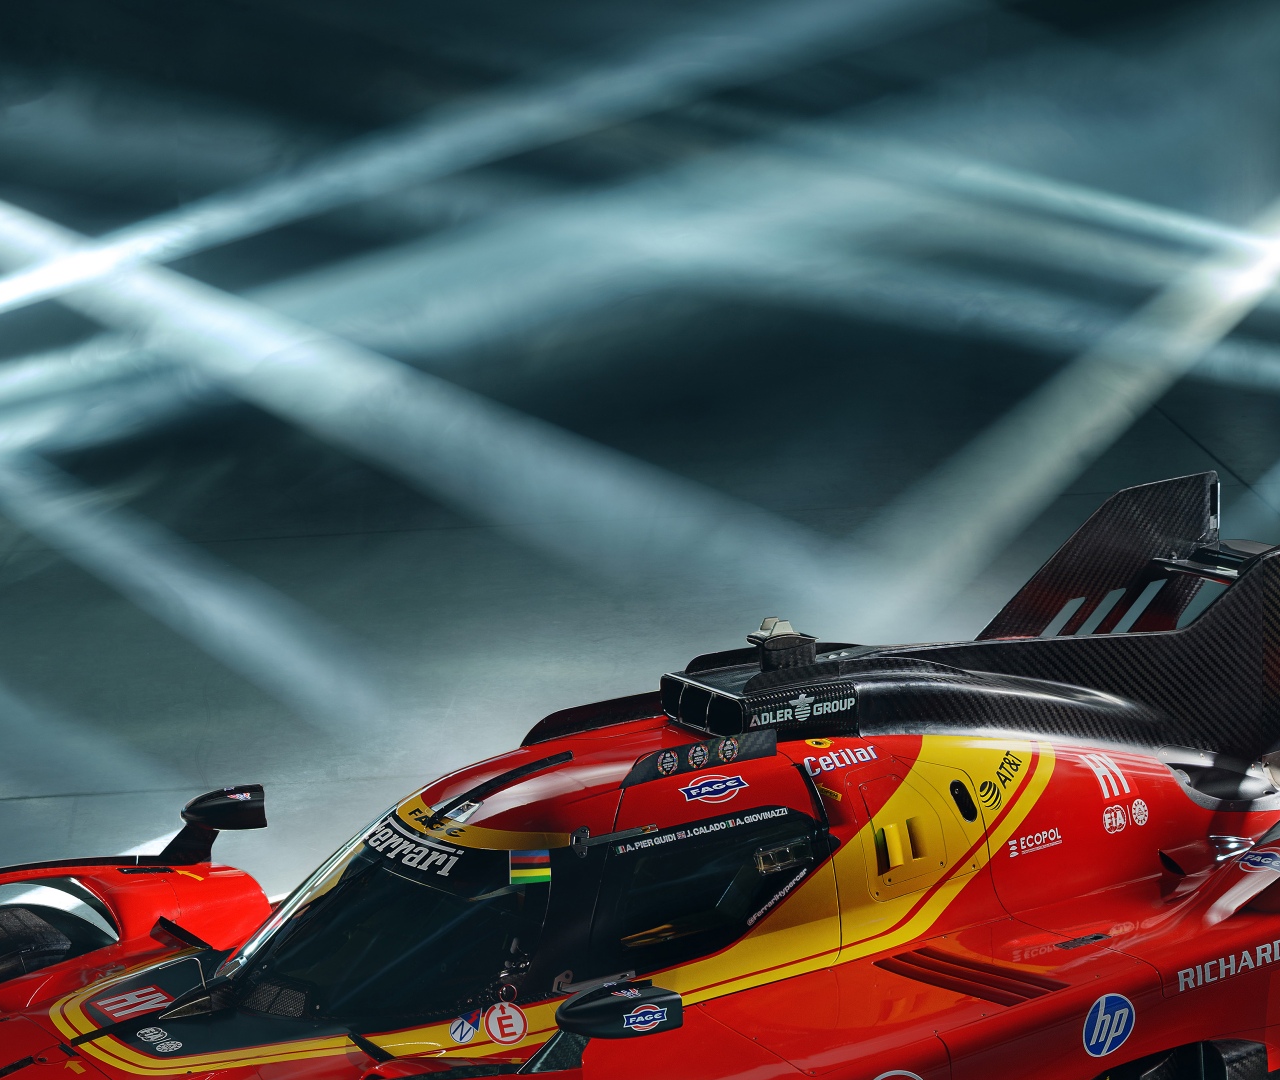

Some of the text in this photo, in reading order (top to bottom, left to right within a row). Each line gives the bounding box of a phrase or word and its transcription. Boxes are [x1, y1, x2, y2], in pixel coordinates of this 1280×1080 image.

[749, 698, 856, 728] ADLER GROUP
[804, 745, 878, 777] Cetilar
[998, 750, 1023, 790] AT&T
[1077, 753, 1131, 799] HY
[690, 778, 740, 796] FAGE
[626, 807, 788, 852] A. PIER GUIDI J. CALADO A. GIOVINAZZI
[1104, 810, 1125, 829] FIA
[1020, 827, 1061, 849] ECOPOL
[747, 868, 807, 926] @FerrariHypercar
[96, 986, 174, 1018] HY
[452, 1020, 472, 1041] N
[497, 1015, 517, 1038] E
[630, 1012, 663, 1024] FAGE
[1090, 998, 1128, 1052] hp
